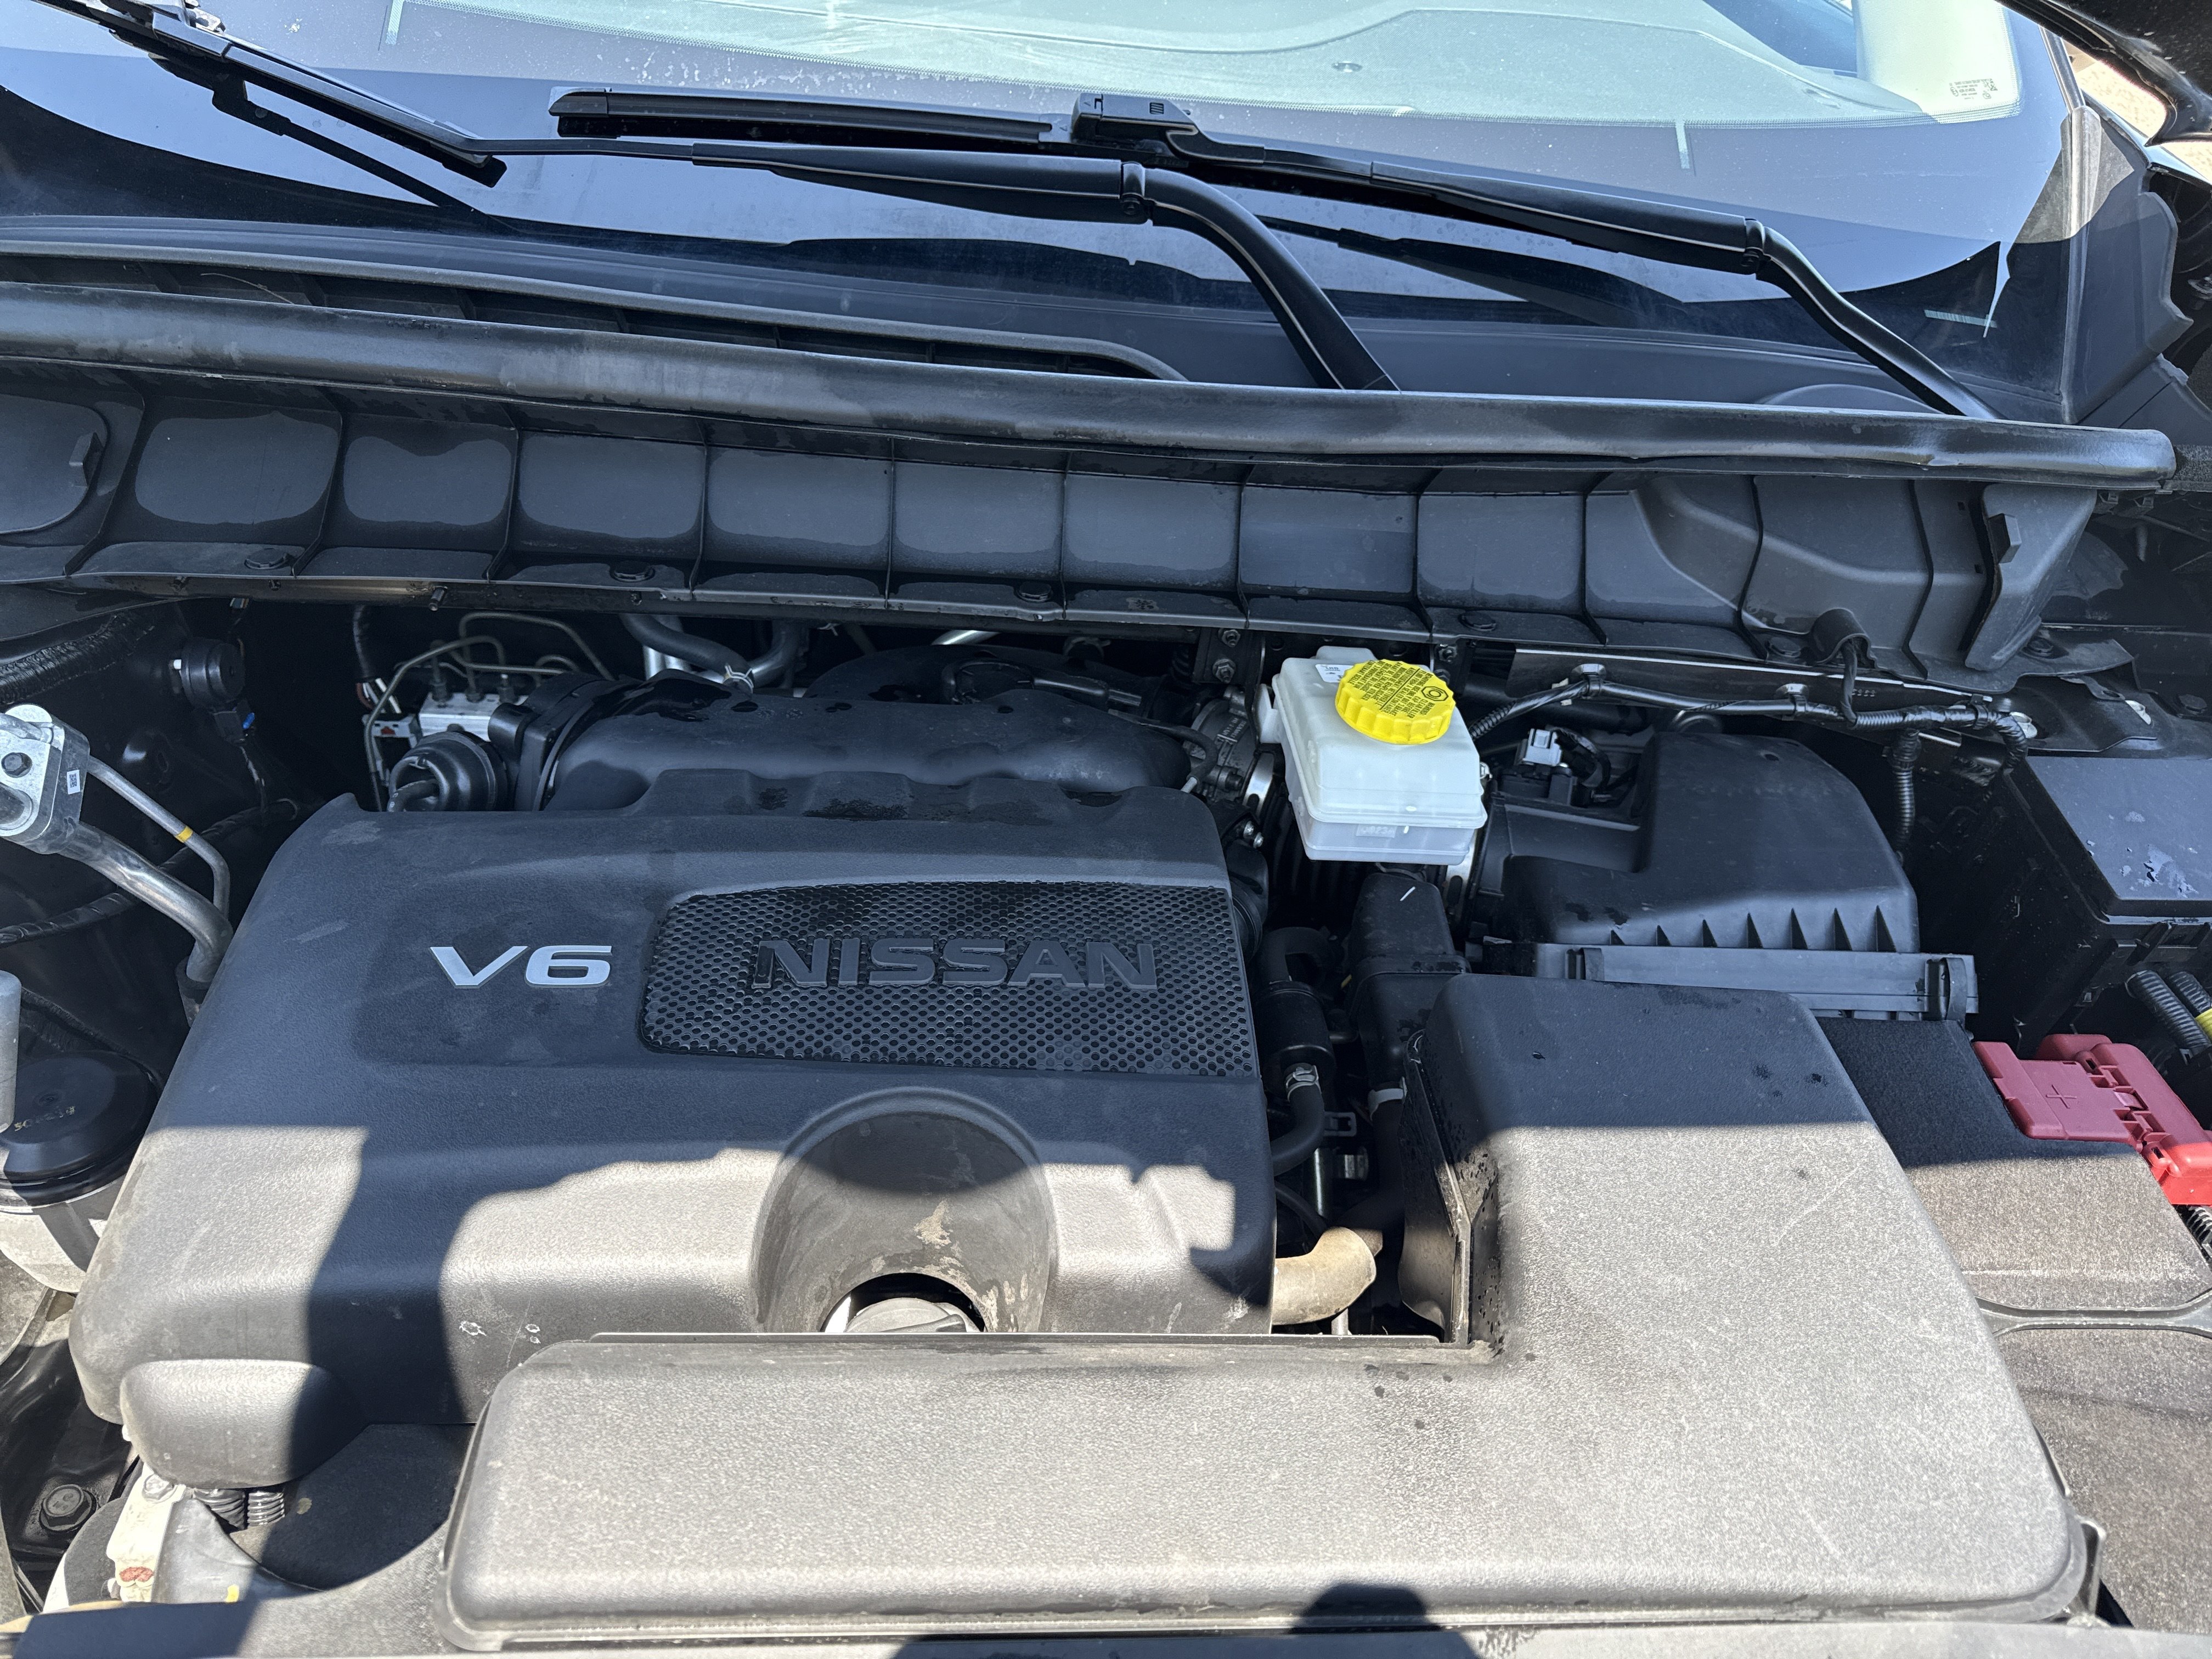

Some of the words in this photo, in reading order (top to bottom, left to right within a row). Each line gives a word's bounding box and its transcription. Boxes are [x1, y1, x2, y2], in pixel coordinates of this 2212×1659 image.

[1390, 662, 1403, 672] AVANT
[1415, 670, 1426, 678] FLUID
[1408, 678, 1419, 686] FROM
[1379, 688, 1396, 702] NETTOYER
[1395, 687, 1410, 698] SEALED
[1401, 702, 1415, 713] BEFORE
[1415, 698, 1429, 709] CLEAN
[1389, 706, 1403, 716] BRAKE
[1406, 708, 1420, 719] FILLER
[430, 945, 612, 989] V6
[751, 938, 1156, 988] NISSAN
